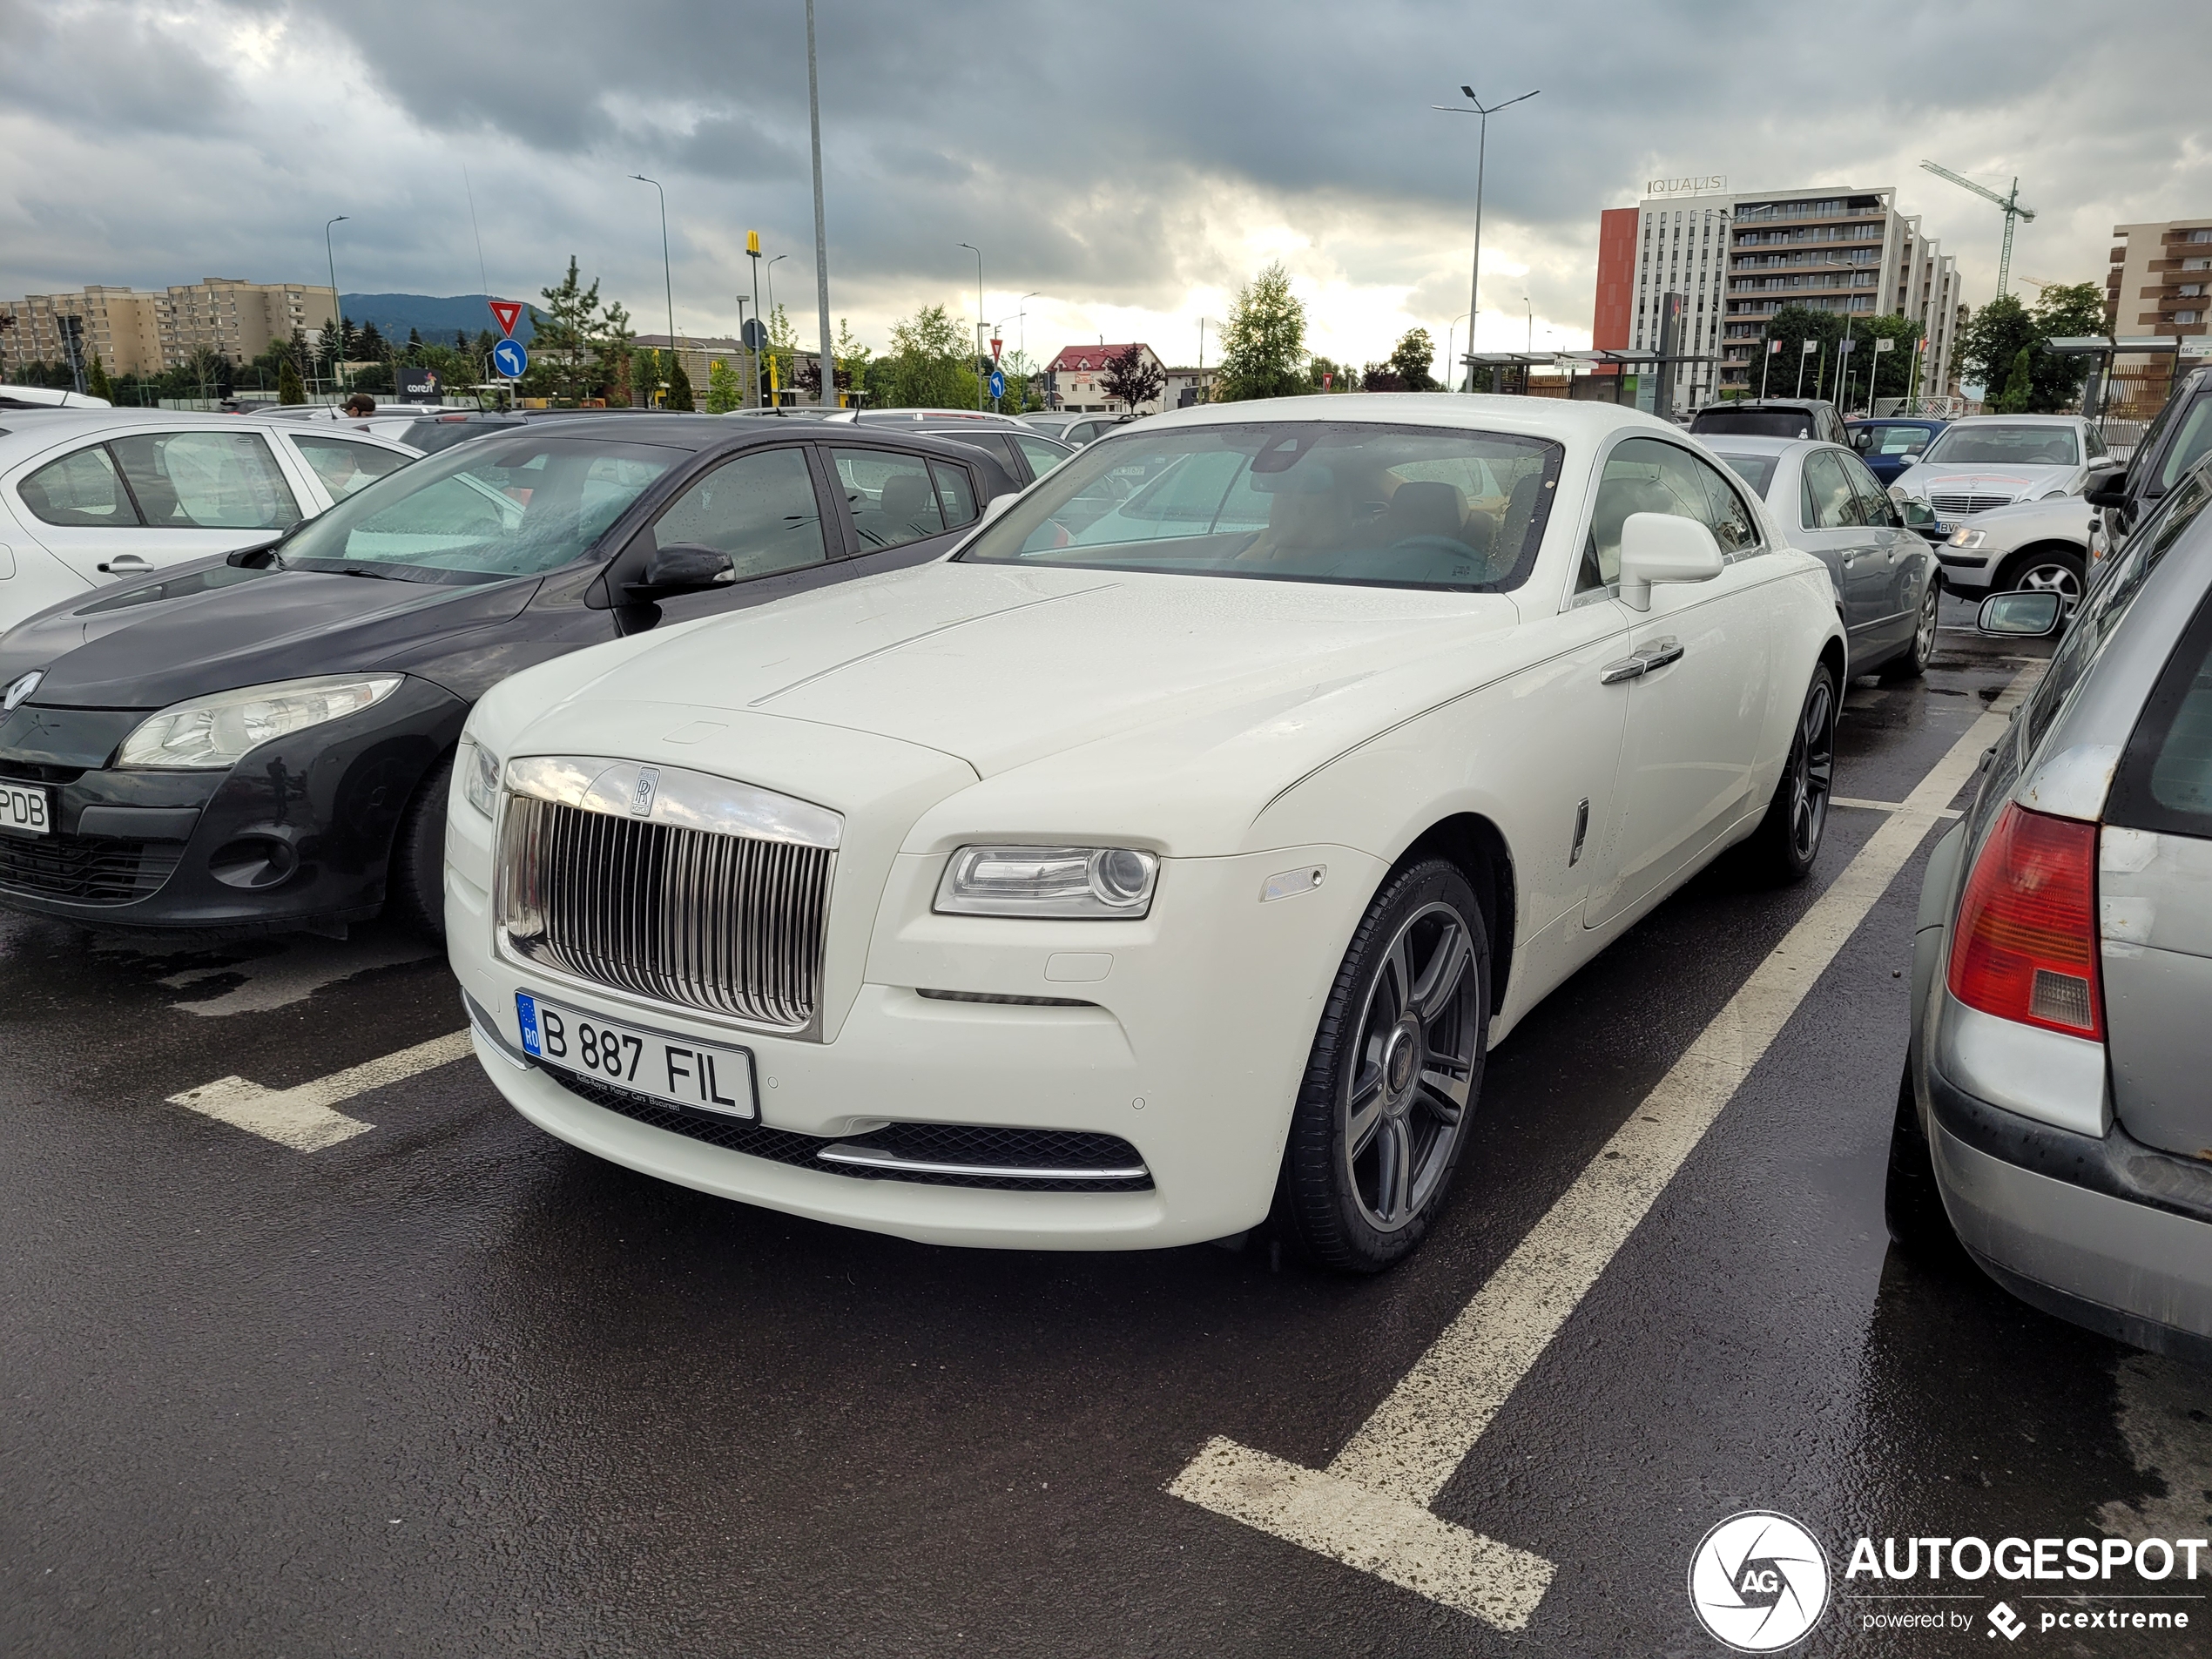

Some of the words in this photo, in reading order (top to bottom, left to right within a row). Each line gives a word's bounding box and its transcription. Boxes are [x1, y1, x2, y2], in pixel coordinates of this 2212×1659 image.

[1653, 175, 1721, 192] QUALIS
[1940, 523, 1955, 532] BV
[0, 789, 45, 826] PDB
[524, 1027, 540, 1048] RO
[542, 1009, 568, 1058] B
[578, 1022, 643, 1082] 887
[664, 1045, 736, 1107] FIL
[576, 1073, 608, 1091] Rolls-Royce
[610, 1085, 629, 1097] Motor
[631, 1092, 646, 1103] Cars
[649, 1097, 680, 1112] Bucuresti
